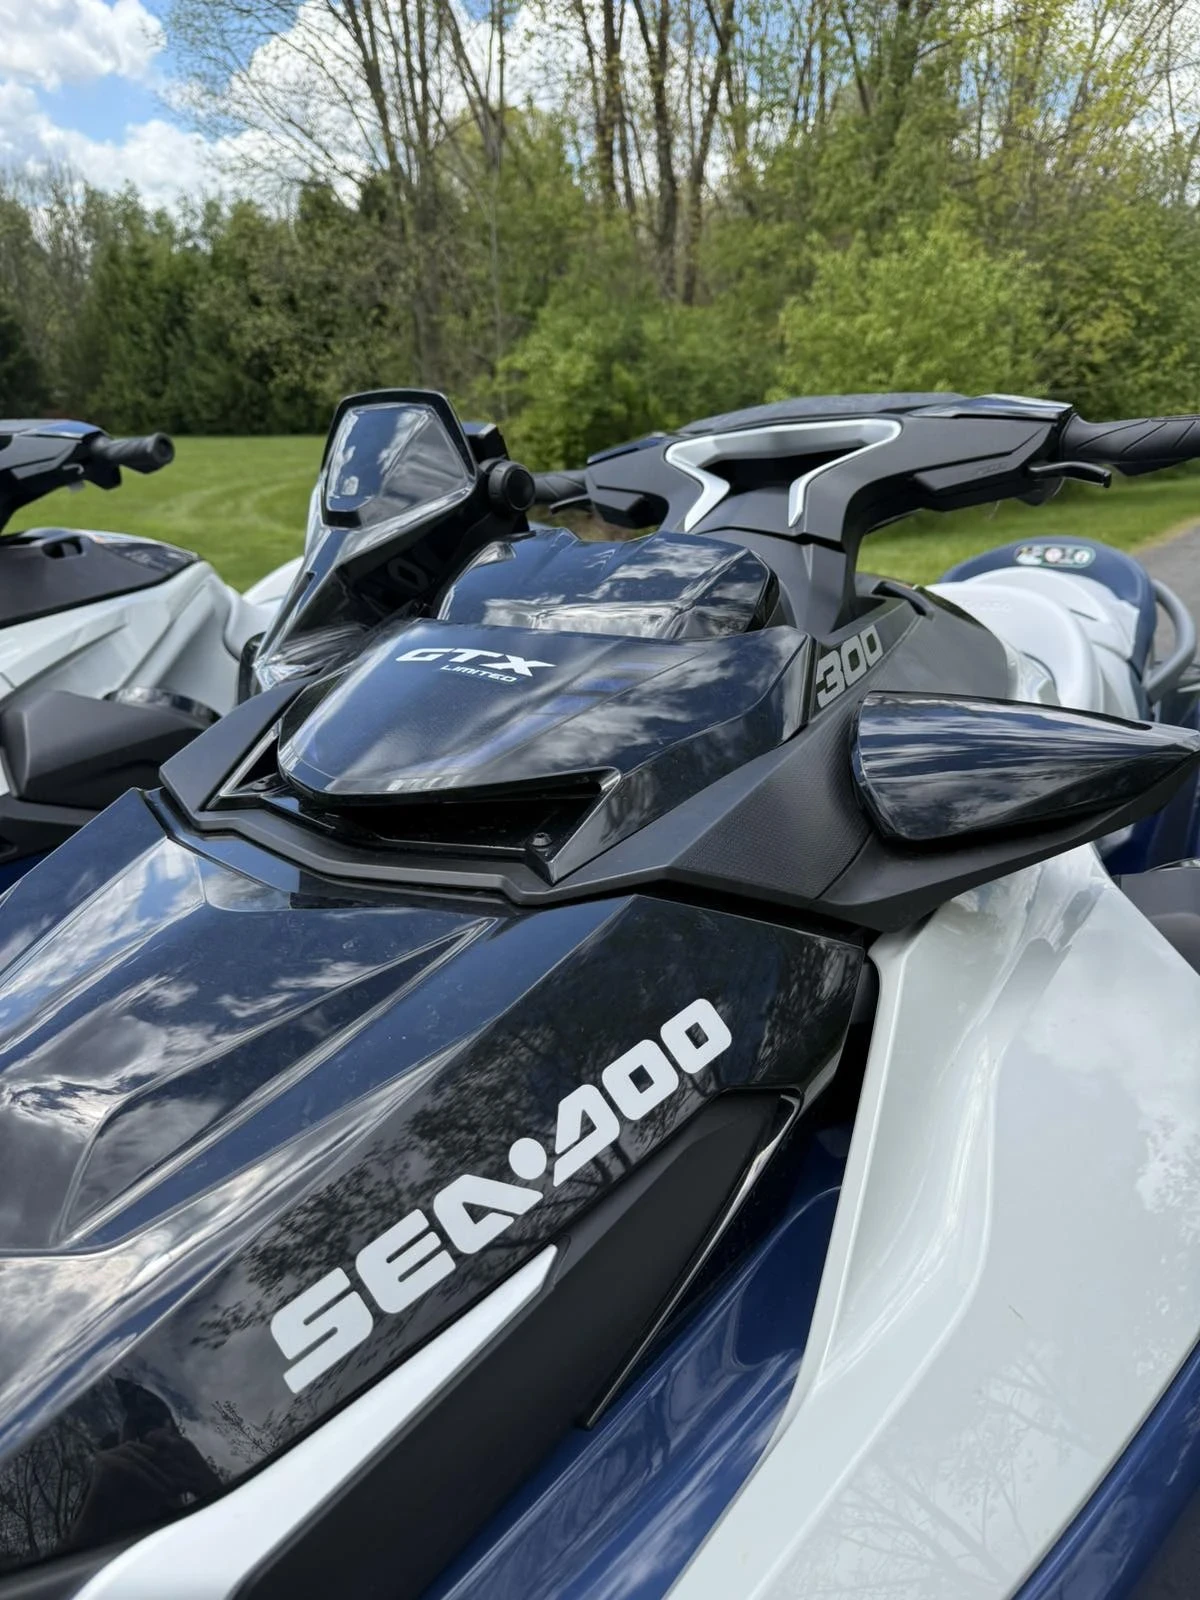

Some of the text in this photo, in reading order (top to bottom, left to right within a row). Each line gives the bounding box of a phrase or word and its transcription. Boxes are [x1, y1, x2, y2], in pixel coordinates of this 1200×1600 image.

[396, 648, 557, 677] GTX
[440, 664, 518, 683] LIMITED
[816, 625, 884, 709] 300
